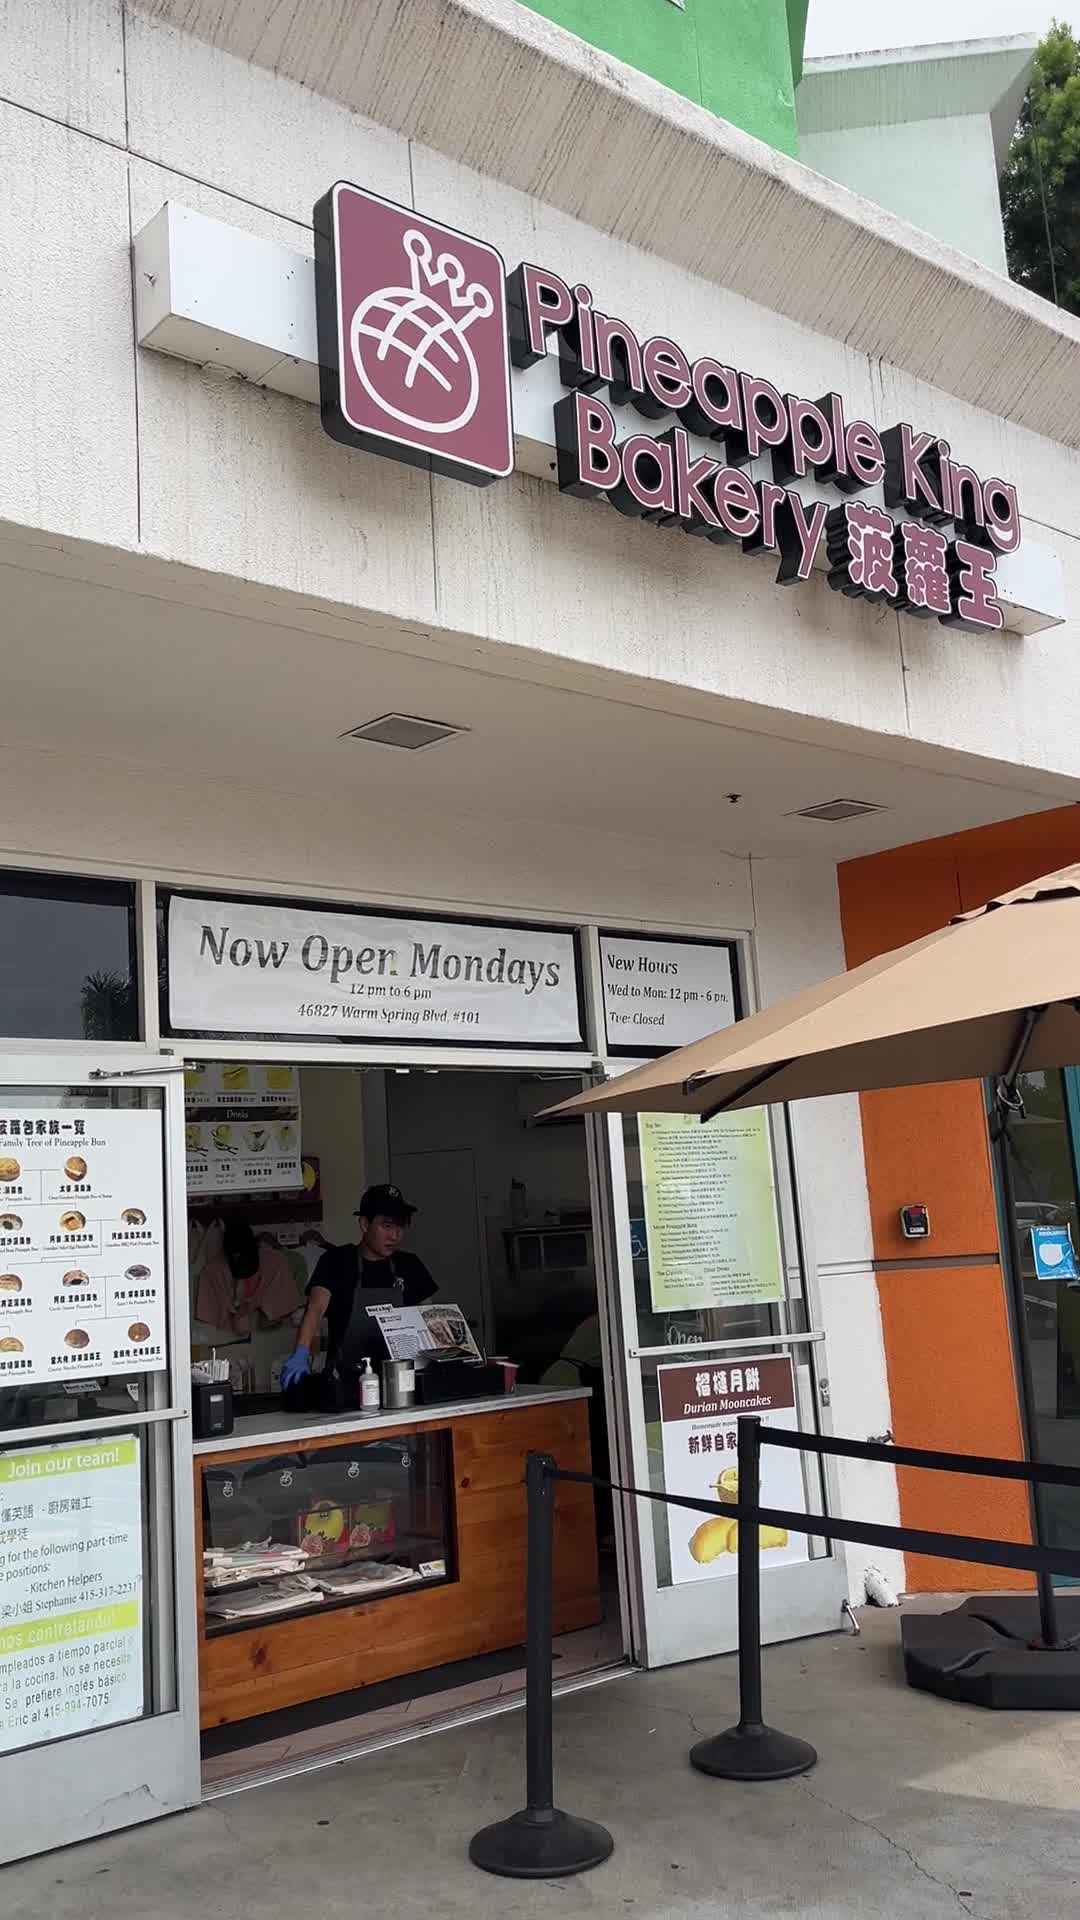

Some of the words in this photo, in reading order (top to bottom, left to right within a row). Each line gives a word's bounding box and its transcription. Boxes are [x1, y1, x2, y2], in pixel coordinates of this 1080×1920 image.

[521, 261, 887, 487] Pineapple
[899, 422, 1022, 553] King
[574, 391, 829, 580] Bakery
[845, 500, 1004, 629] 菠蘿王
[199, 924, 290, 969] Now
[409, 941, 562, 996] Mondays
[638, 956, 679, 975] Hours
[350, 983, 364, 995] 12
[367, 986, 386, 998] pm
[390, 985, 401, 997] to
[403, 986, 411, 998] 6
[413, 988, 432, 1001] pm
[607, 983, 629, 997] Wed
[631, 986, 641, 998] to
[643, 986, 667, 999] Mon:
[669, 988, 681, 1000] 12
[683, 991, 699, 1004] pm
[706, 990, 713, 1002] 6
[297, 1003, 338, 1017] 46827
[341, 1005, 378, 1019] Warm
[381, 1008, 420, 1025] Spring
[453, 1011, 480, 1024] #101
[633, 1012, 666, 1026] Closed
[25, 1138, 43, 1148] Tree
[44, 1138, 53, 1147] of
[54, 1138, 90, 1149] Pineapple
[91, 1138, 106, 1147] Bun
[683, 1401, 718, 1415] Durian
[719, 1395, 772, 1411] Mooncakes
[8, 1459, 41, 1479] Join
[45, 1456, 73, 1473] our
[76, 1447, 120, 1468] team!
[8, 1551, 21, 1563] for
[23, 1548, 39, 1560] the
[40, 1542, 85, 1557] following
[87, 1533, 129, 1551] part-time
[6, 1562, 51, 1581] positions:
[30, 1579, 66, 1594] Kitchen
[67, 1572, 103, 1587] Helpers
[35, 1597, 77, 1611] Stephanie
[79, 1581, 137, 1601] 415-317-2231
[48, 1653, 55, 1664] a
[58, 1645, 91, 1662] tiempo
[93, 1635, 126, 1655] parcial
[12, 1672, 21, 1690] la
[62, 1665, 76, 1678] No
[79, 1664, 90, 1675] se
[25, 1687, 62, 1708] prefiere
[31, 1710, 41, 1723] al
